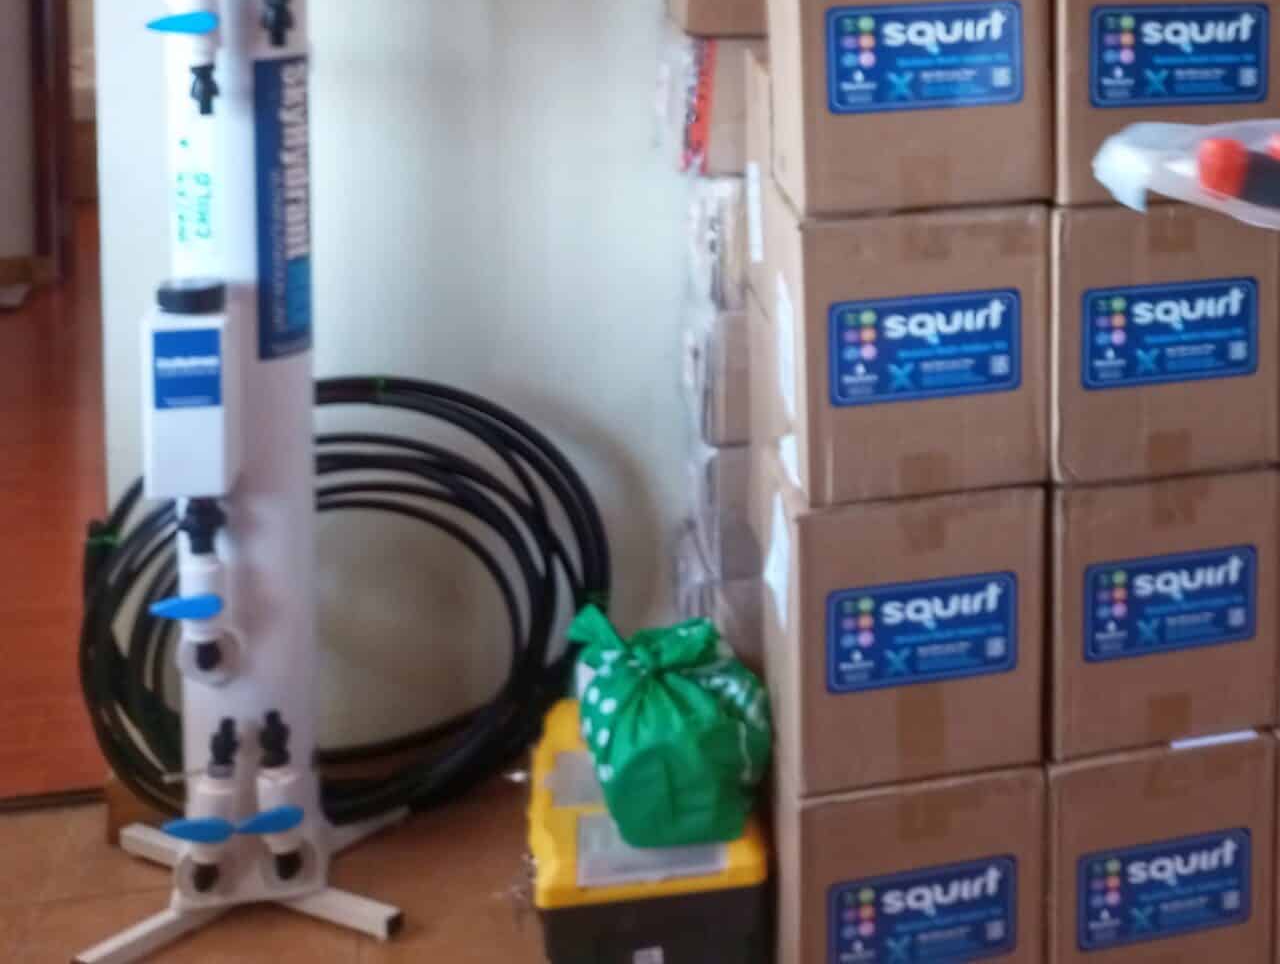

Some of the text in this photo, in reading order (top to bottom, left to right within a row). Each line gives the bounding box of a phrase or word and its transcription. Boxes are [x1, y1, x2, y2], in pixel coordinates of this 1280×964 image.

[882, 9, 1007, 55] squirt
[1141, 11, 1256, 53] squirt
[883, 298, 1007, 345] squirt
[1132, 286, 1246, 331] squirt
[1133, 555, 1244, 601] squirt
[881, 581, 1002, 630] squirt
[1127, 839, 1238, 887] squirt
[881, 866, 1002, 916] squirt
